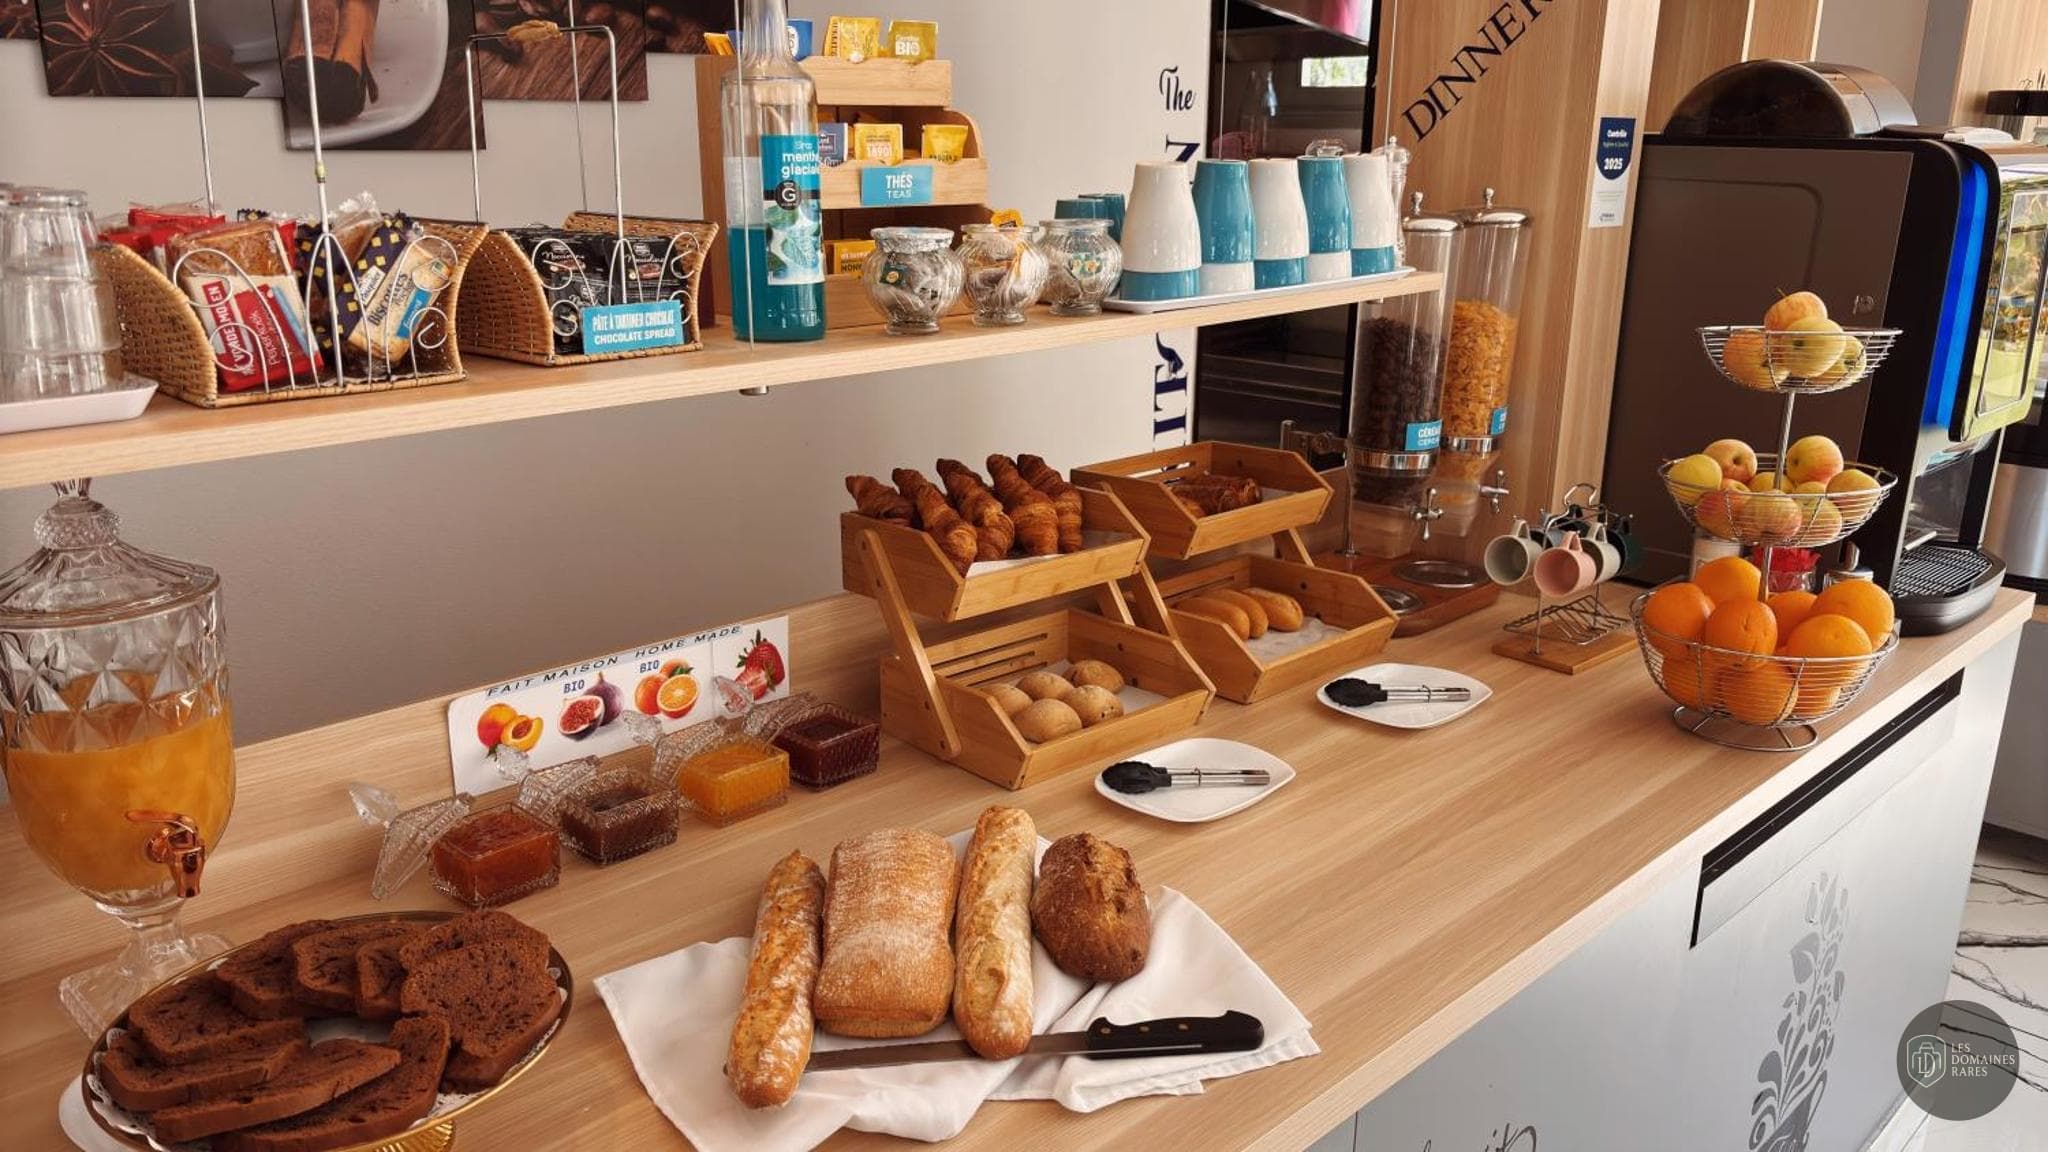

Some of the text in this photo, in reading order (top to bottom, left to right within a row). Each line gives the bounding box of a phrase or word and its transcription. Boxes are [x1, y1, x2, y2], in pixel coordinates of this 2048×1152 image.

[895, 41, 921, 56] BIO
[1159, 65, 1197, 111] The
[1603, 157, 1624, 170] 2025
[885, 172, 913, 189] THÉS
[781, 187, 797, 203] G
[886, 189, 912, 200] TEAS
[594, 328, 676, 345] CHOCOLATE SPREAD
[487, 626, 742, 697] FAIT MAISON HOME MADE
[639, 659, 660, 674] BIO
[563, 679, 586, 695] BIO
